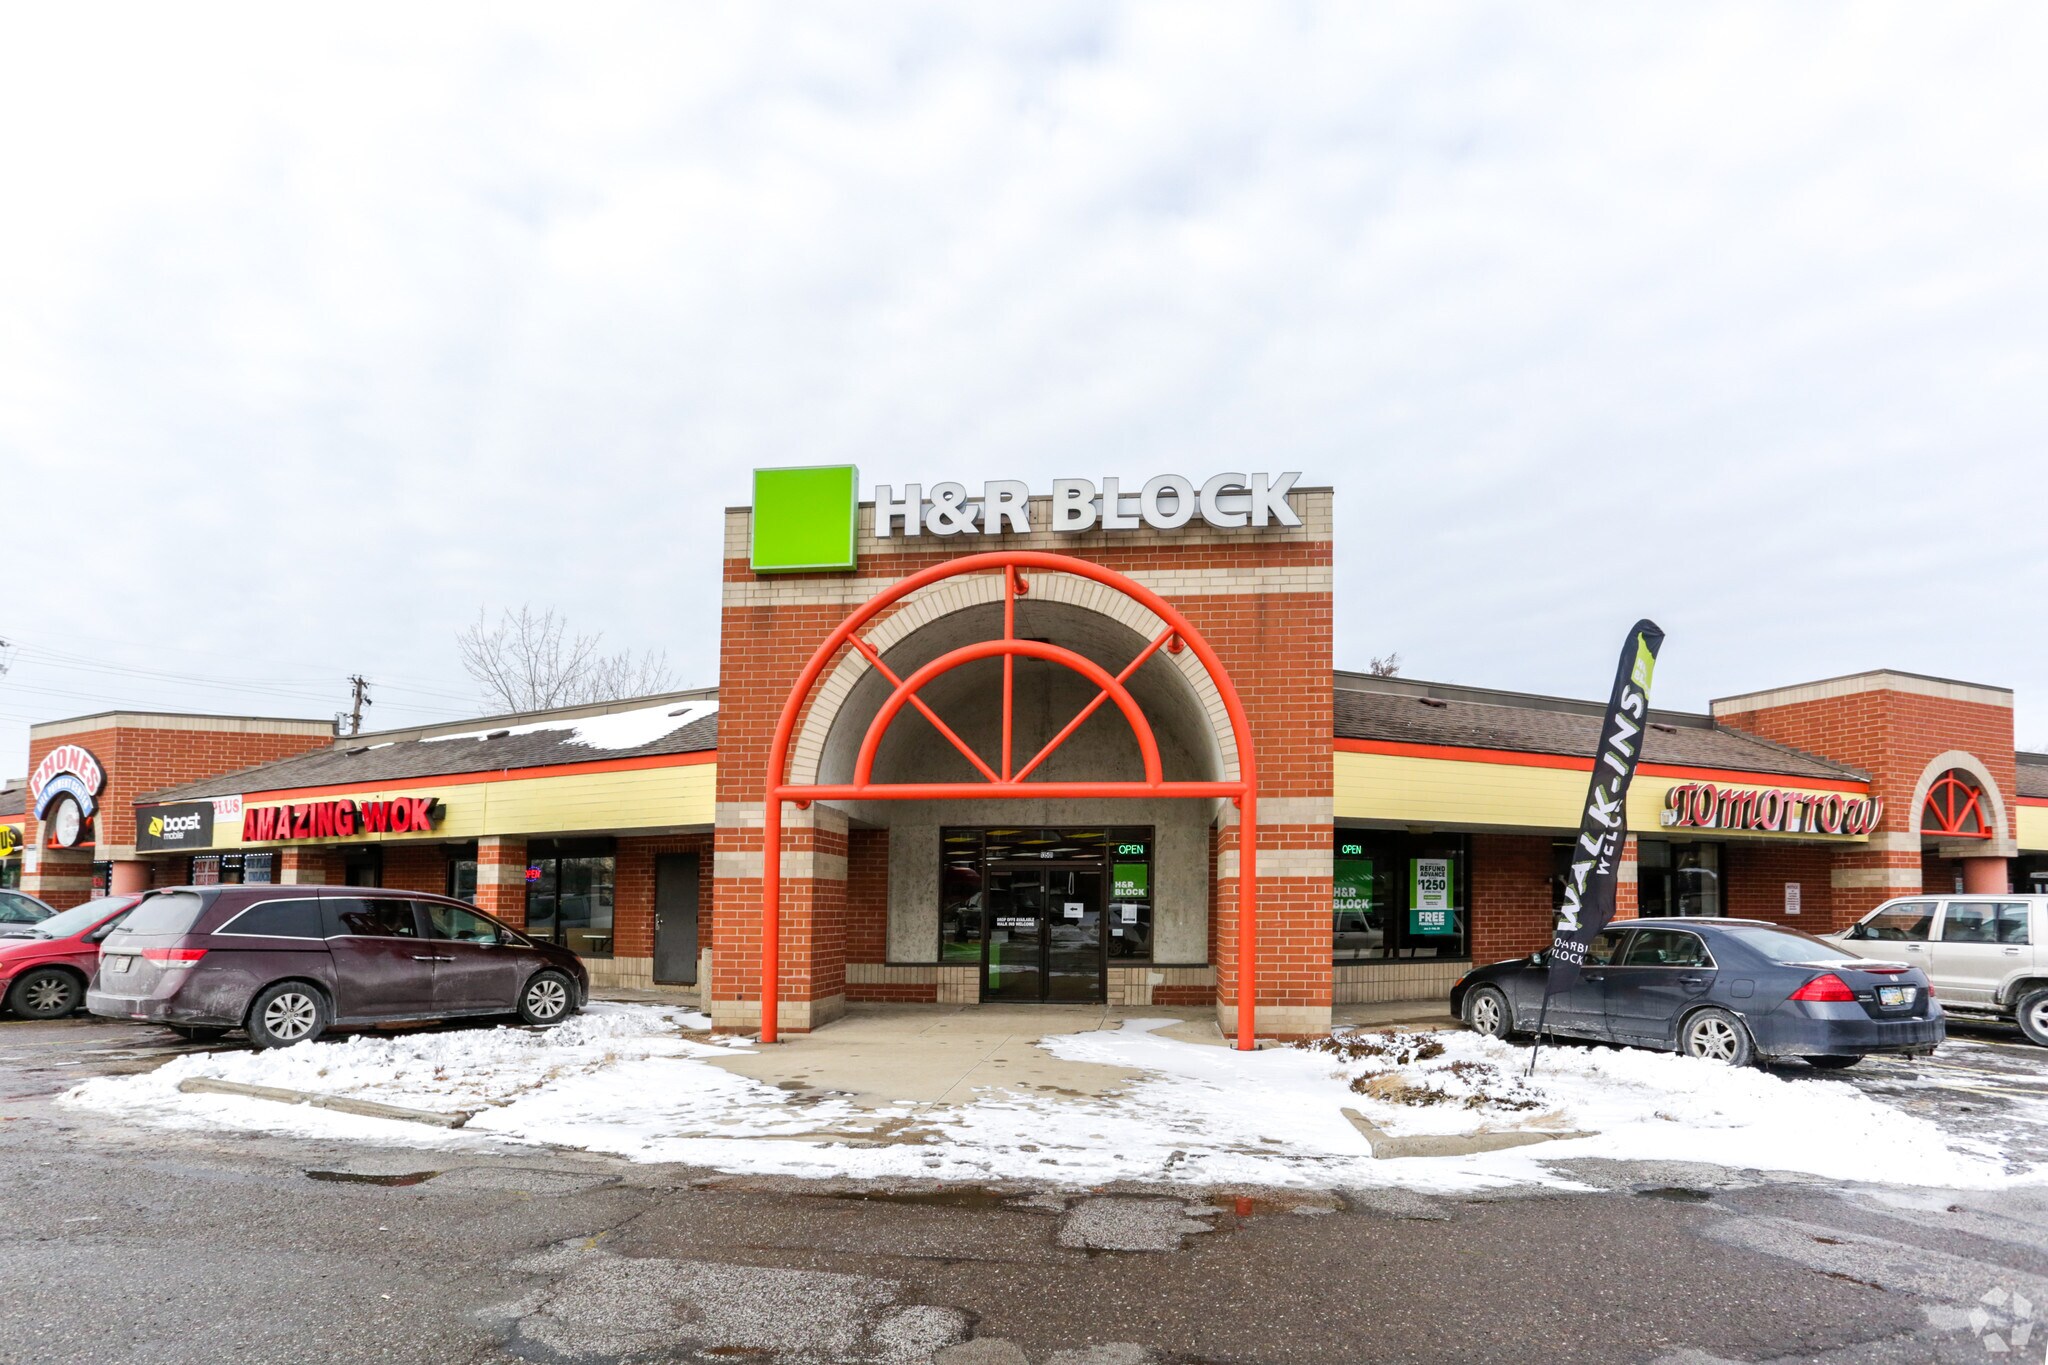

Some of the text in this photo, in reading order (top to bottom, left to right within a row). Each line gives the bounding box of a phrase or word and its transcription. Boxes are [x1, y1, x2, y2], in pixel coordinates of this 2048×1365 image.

[875, 471, 1302, 538] H&R BLOCK
[32, 748, 99, 797] PHONES
[213, 799, 240, 815] PLUS
[1557, 684, 1643, 931] WALK-INS
[163, 812, 201, 832] boost
[242, 797, 436, 842] AMAZING WOK
[163, 831, 184, 840] mobile
[1119, 844, 1144, 855] OPEN
[1342, 844, 1362, 854] OPEN
[526, 869, 541, 879] OPEN
[1418, 879, 1446, 890] $1250
[1115, 888, 1145, 896] BLOCK
[1334, 887, 1357, 897] H&R
[1333, 899, 1370, 909] BLOCK
[1419, 912, 1445, 922] FREE
